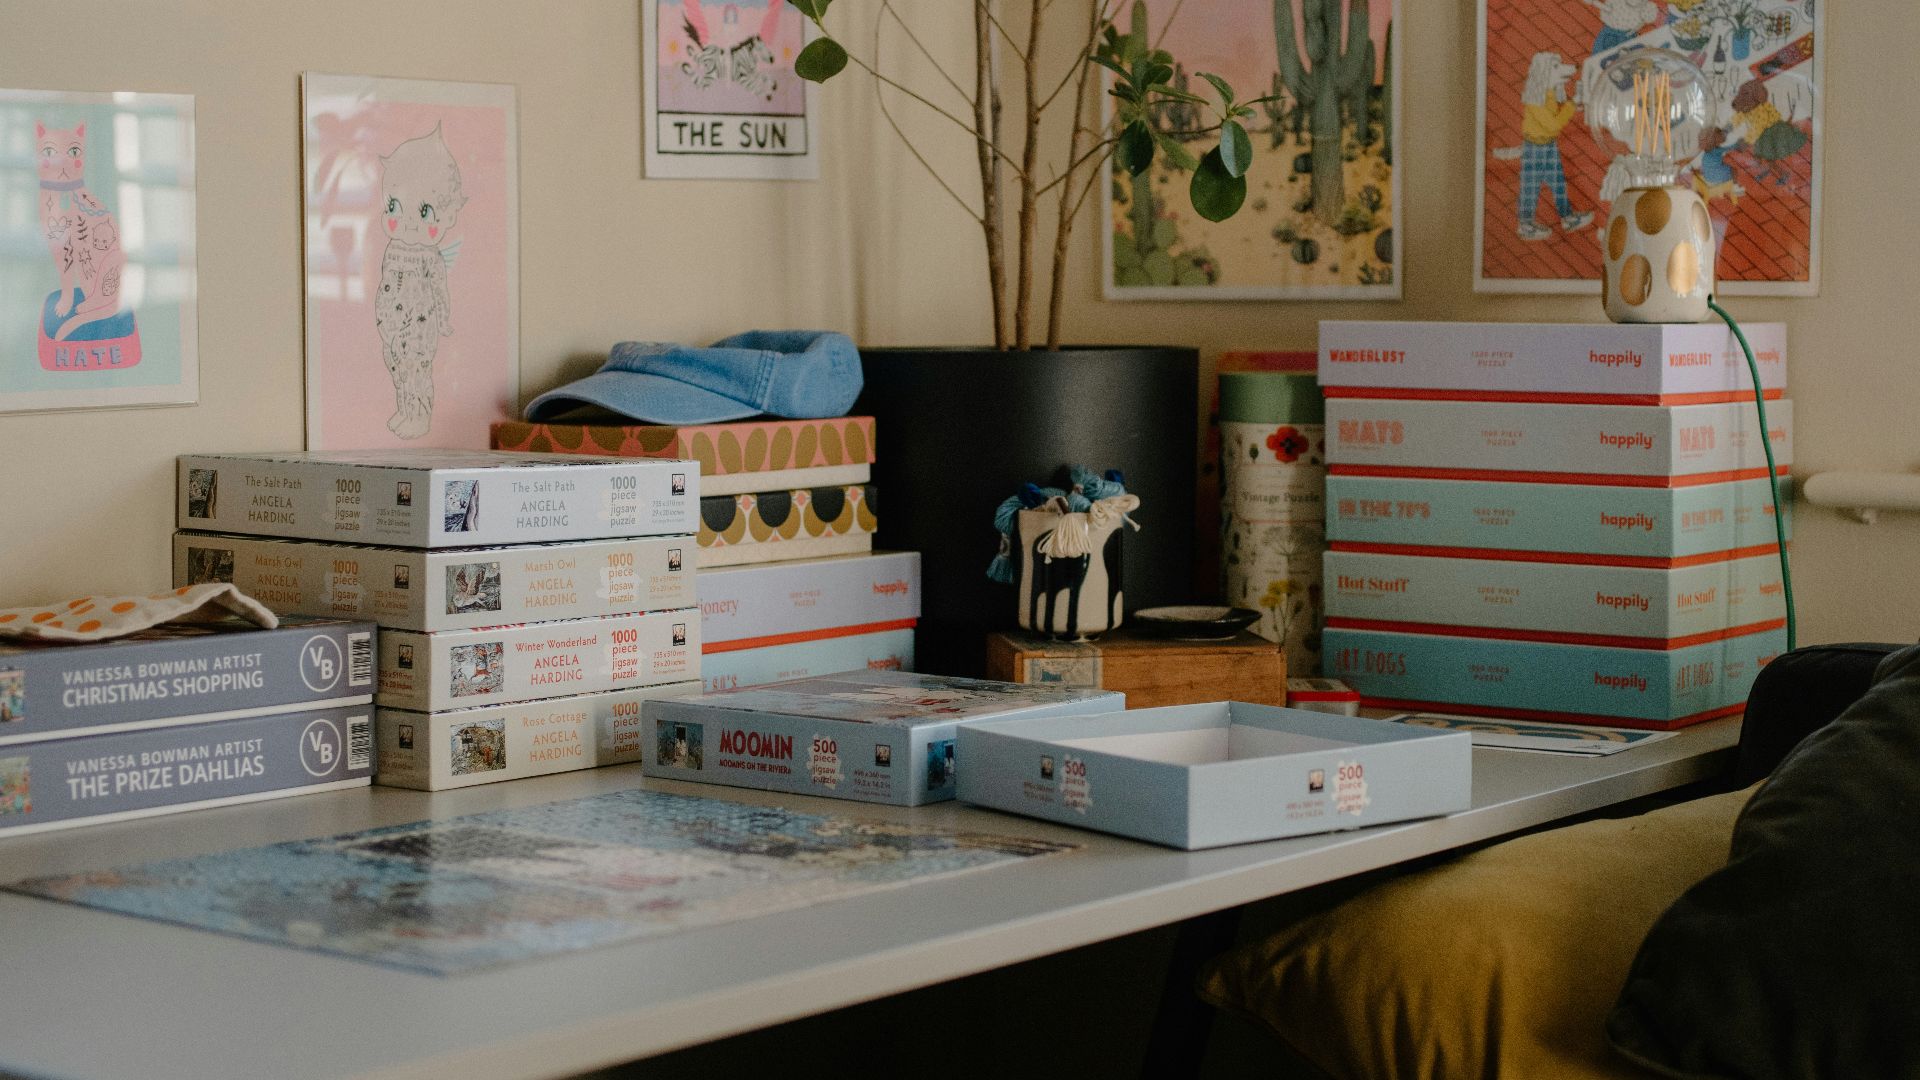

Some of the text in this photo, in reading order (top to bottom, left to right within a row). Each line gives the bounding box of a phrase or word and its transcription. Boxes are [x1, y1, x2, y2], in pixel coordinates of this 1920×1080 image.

[673, 122, 787, 148] THE SUN
[55, 346, 122, 367] HATE
[1329, 349, 1405, 364] WANDERLUST
[1589, 350, 1642, 367] happily
[1669, 352, 1712, 368] WANDERLUST
[1600, 432, 1653, 449] happily
[245, 475, 302, 490] The Salt Path
[335, 478, 362, 494] 1000
[512, 480, 575, 493] The Salt Path
[610, 475, 637, 490] 1000
[251, 494, 293, 509] ANGELA
[335, 494, 361, 506] piece
[611, 490, 637, 501] piece
[334, 508, 361, 520] jigsaw
[520, 500, 566, 513] ANGELA
[610, 503, 637, 516] jigsaw
[248, 510, 295, 525] HARDING
[516, 515, 569, 528] HARDING
[610, 516, 636, 529] puzzle
[1600, 512, 1653, 530] happily
[334, 521, 361, 532] puzzle
[255, 555, 303, 569] Marsh Owl
[332, 560, 359, 575] 1000
[524, 558, 576, 573] Marsh Owl
[607, 553, 634, 567] 1000
[257, 574, 299, 588] ANGELA
[332, 575, 358, 586] piece
[608, 568, 634, 580] piece
[528, 578, 574, 592] ANGELA
[609, 581, 634, 594] jigsaw
[1337, 576, 1409, 592] Hot Stuff
[254, 589, 301, 604] HARDING
[332, 589, 359, 601] jigsaw
[525, 593, 577, 608] HARDING
[609, 593, 634, 607] puzzle
[1596, 591, 1649, 611] happily
[1677, 592, 1692, 608] Hot
[332, 602, 358, 614] puzzle
[515, 634, 597, 653] Winter Wonderland
[611, 629, 638, 644] 1000
[612, 643, 638, 655] piece
[62, 653, 263, 685] VANESSA BOWMAN ARTIST
[534, 654, 580, 669] ANGELA
[612, 658, 638, 670] jigsaw
[530, 669, 583, 685] HARDING
[612, 668, 638, 682] puzzle
[1594, 671, 1647, 693] happily
[62, 670, 264, 709] CHRISTMAS SHOPPING
[612, 702, 639, 717] 1000
[522, 711, 587, 728] Rose Cottage
[613, 717, 639, 729] piece
[533, 730, 578, 745] ANGELA
[613, 730, 640, 744] jigsaw
[719, 728, 793, 761] MOOMIN
[529, 745, 582, 762] HARDING
[614, 743, 640, 756] puzzle
[813, 739, 837, 754] 500
[66, 738, 263, 776] VANESSA BOWMAN ARTIST
[813, 753, 837, 764] piece
[757, 762, 767, 771] THE
[768, 763, 792, 775] RIVIERA
[813, 764, 836, 775] jigsaw
[1064, 760, 1087, 777] 500
[1338, 764, 1364, 781] 500
[66, 755, 265, 800] THE PRIZE DAHLIAS
[813, 775, 837, 785] puzzle
